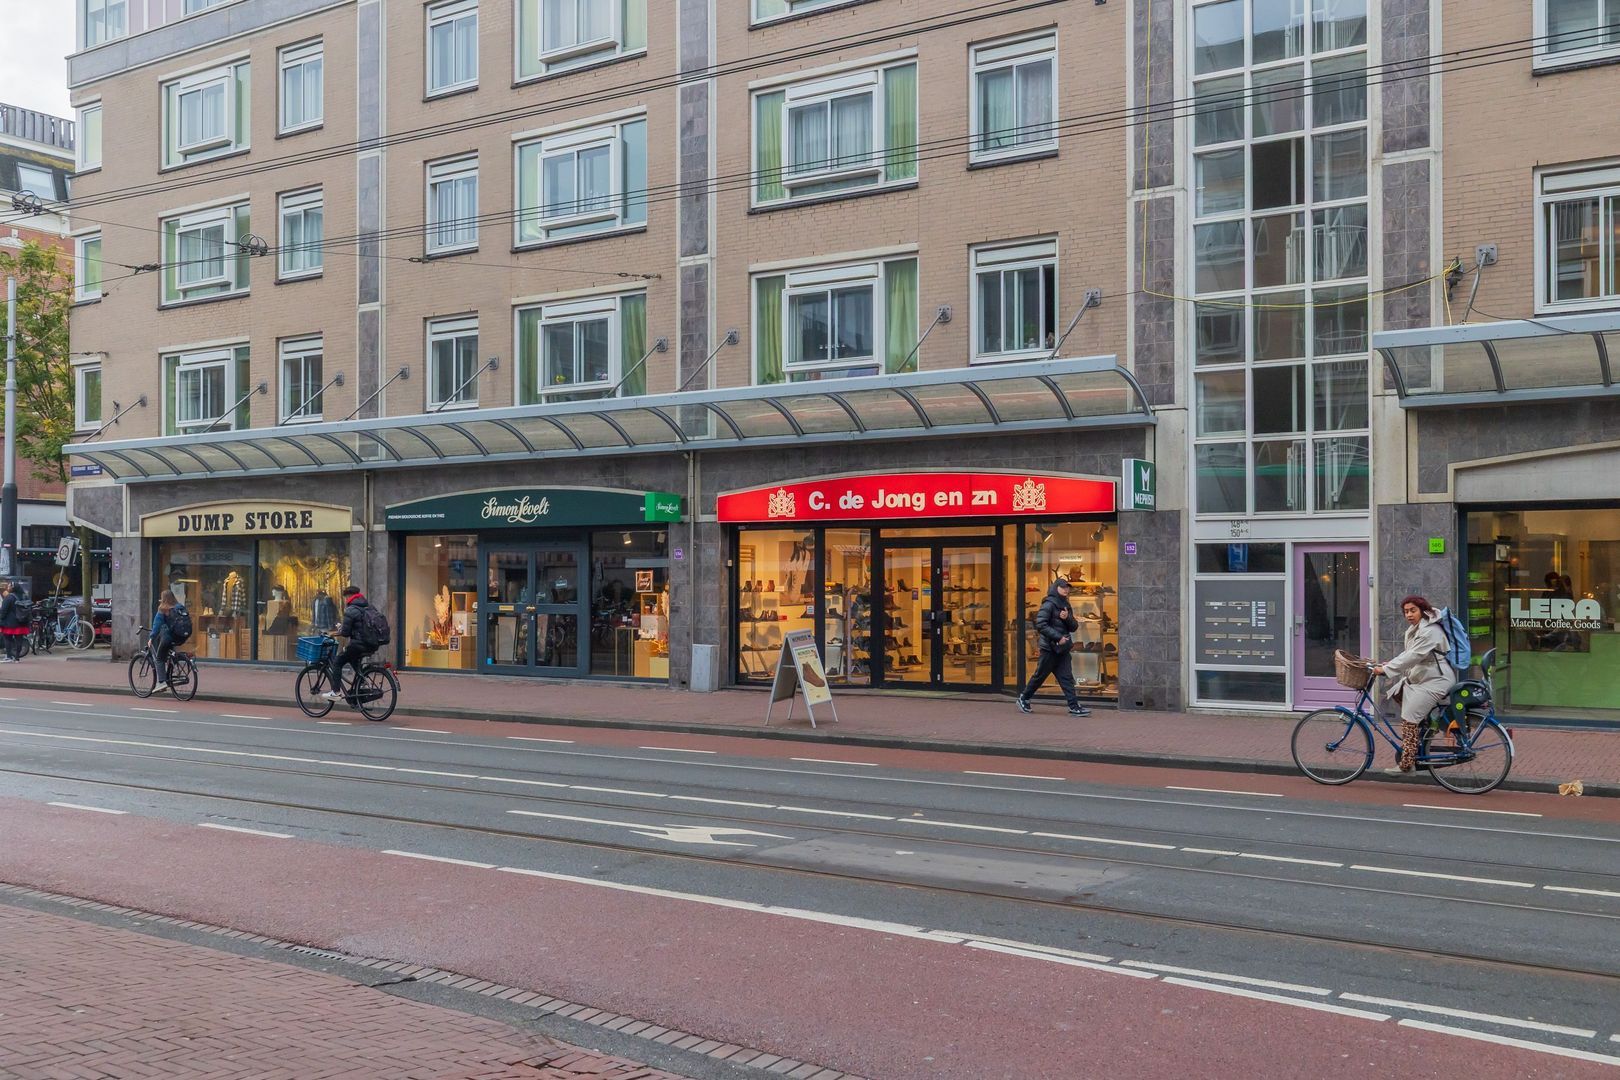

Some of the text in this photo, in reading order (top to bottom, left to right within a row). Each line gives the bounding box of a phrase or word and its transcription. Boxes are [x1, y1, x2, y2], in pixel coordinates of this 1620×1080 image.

[808, 489, 997, 511] C. de Jong en zn
[178, 510, 313, 532] DUMP STORE
[1510, 598, 1600, 619] LERA
[1510, 618, 1601, 629] Matcha, Coffee, Goods
